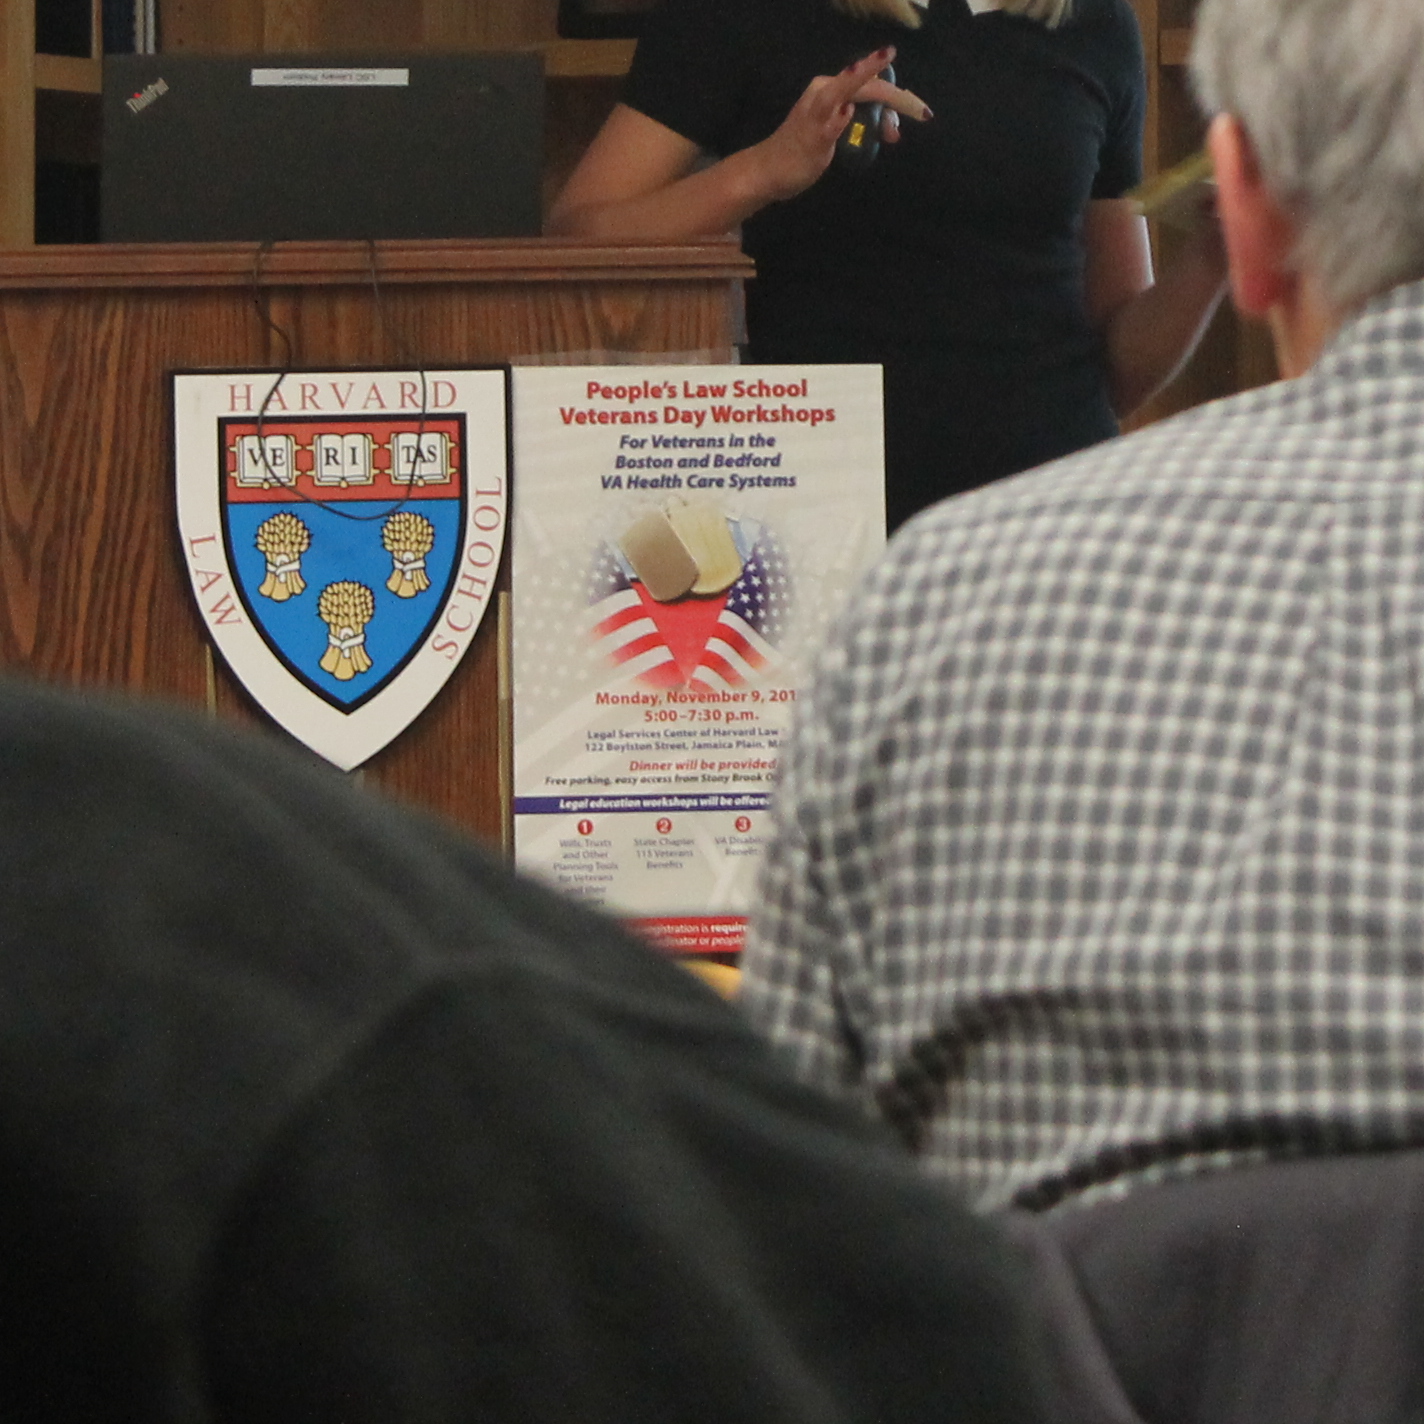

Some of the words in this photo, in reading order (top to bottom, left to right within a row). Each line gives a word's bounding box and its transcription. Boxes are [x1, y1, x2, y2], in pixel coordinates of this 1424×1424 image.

[125, 77, 170, 113] ThinkPad
[228, 380, 458, 412] HARVARD
[586, 381, 678, 404] People's
[683, 380, 727, 399] Law
[732, 379, 808, 399] School
[559, 407, 658, 425] Veterans
[663, 406, 706, 428] Day
[710, 404, 836, 426] Workshops
[619, 434, 646, 449] For
[651, 434, 726, 449] Veterans
[729, 434, 744, 448] in
[748, 433, 776, 448] the
[615, 454, 673, 469] Boston
[677, 454, 709, 468] and
[713, 452, 782, 468] Bedford
[600, 475, 623, 490] VA
[627, 474, 682, 489] Health
[686, 474, 725, 488] Care
[728, 473, 797, 491] Systems
[431, 476, 502, 660] SCHOOL
[188, 532, 242, 629] LAW
[595, 691, 663, 708] Monday,
[666, 689, 748, 705] November
[750, 690, 765, 705] 9,
[768, 689, 797, 703] 201
[725, 710, 760, 724] p.m.
[587, 730, 617, 742] Legal
[619, 729, 662, 740] Services
[663, 728, 697, 739] Center
[698, 728, 711, 739] of
[712, 727, 756, 738] Harvard
[757, 727, 779, 738] Law
[584, 743, 604, 753] 122
[606, 742, 653, 754] Boylston
[692, 740, 734, 752] Jamaica
[735, 740, 765, 751] Plain,
[629, 760, 673, 773] Dinner
[675, 759, 698, 772] will
[700, 759, 716, 771] be
[545, 777, 567, 787] Free
[615, 777, 638, 787] easy
[639, 776, 673, 785] access
[675, 774, 699, 784] from
[700, 773, 730, 785] Stony
[732, 773, 763, 783] Brook
[559, 798, 589, 811] Legal
[590, 797, 641, 809] education
[643, 796, 699, 810] workshops
[700, 796, 718, 808] will
[719, 795, 733, 807] be
[654, 848, 694, 859] Veterans
